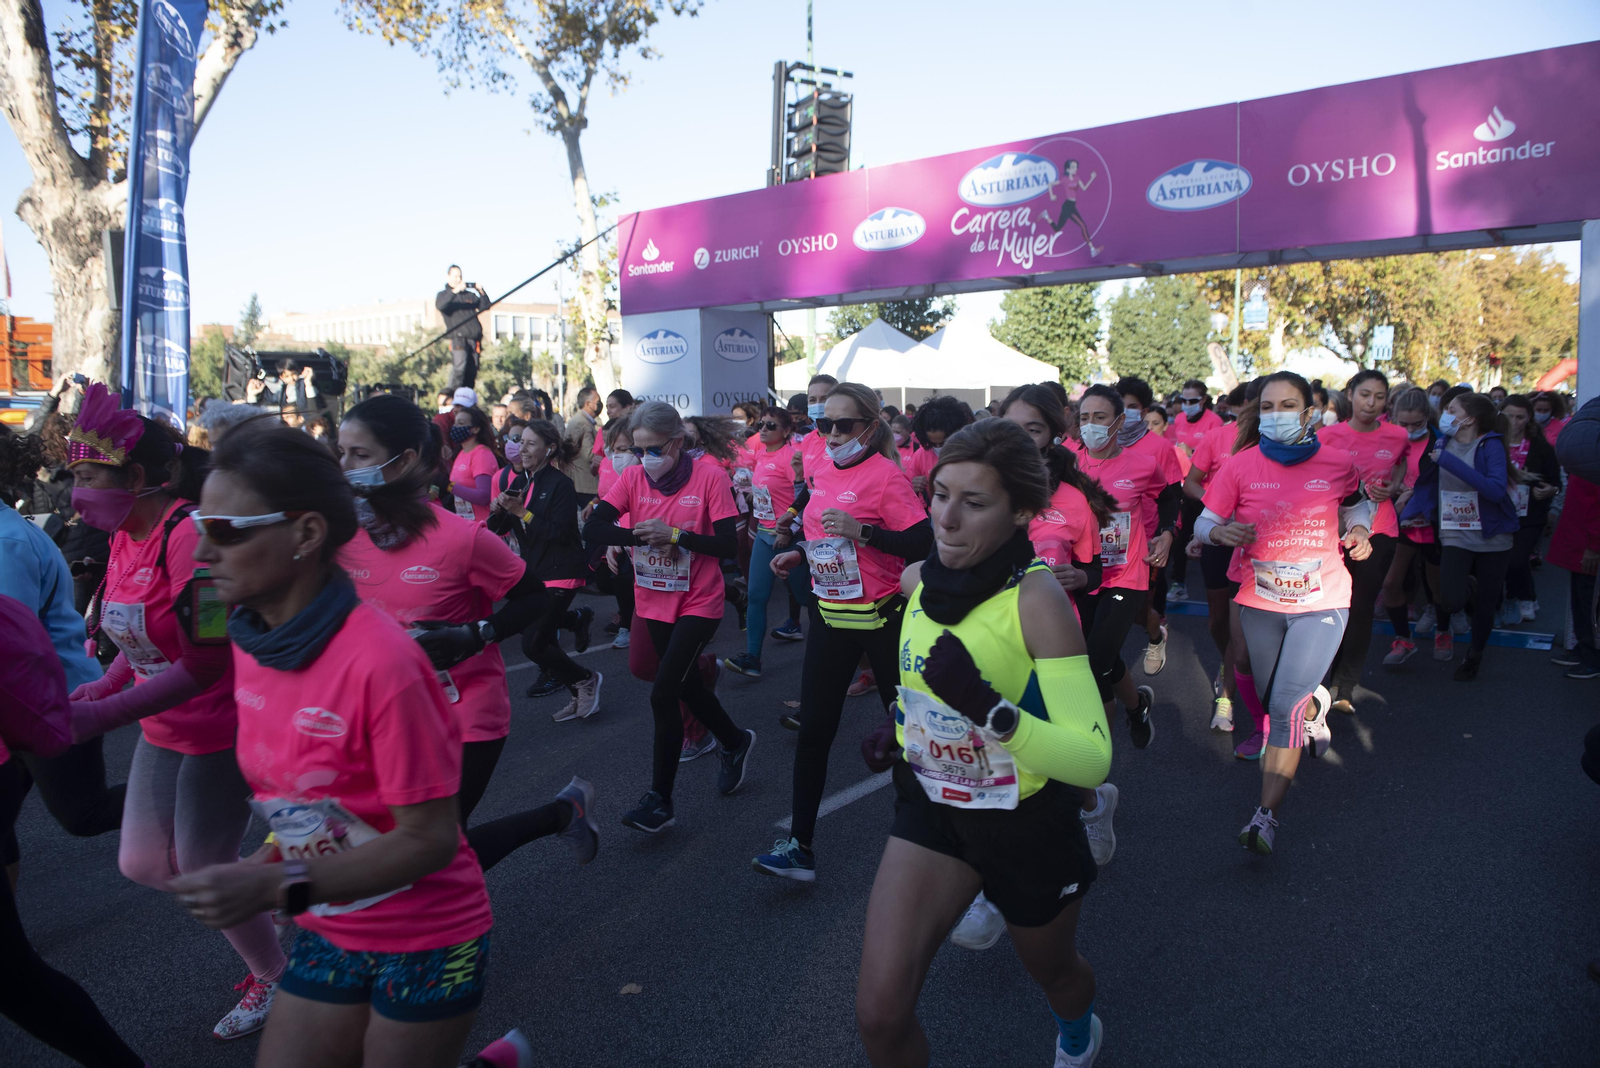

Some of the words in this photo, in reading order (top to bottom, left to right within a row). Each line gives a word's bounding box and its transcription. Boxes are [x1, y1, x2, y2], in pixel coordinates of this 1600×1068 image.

[1435, 141, 1556, 171] Santander
[1287, 152, 1396, 186] OYSHO
[967, 172, 1050, 197] ASTURIANA
[1155, 178, 1243, 202] ASTURIANA
[951, 207, 1031, 235] Carrera
[860, 225, 919, 243] ASTURIANA
[778, 232, 838, 256] OYSHO
[970, 233, 986, 253] de
[988, 232, 999, 251] la
[997, 222, 1063, 269] Mujer
[714, 245, 759, 263] ZURICH
[628, 261, 674, 277] Santander
[640, 344, 684, 356] ASTURIANA
[717, 339, 757, 354] ASTURIANA
[1250, 482, 1281, 490] OYSHO
[1453, 506, 1471, 515] 016
[1304, 519, 1326, 527] POR
[1100, 533, 1114, 544] 16
[1290, 529, 1325, 537] TODAS
[1268, 538, 1324, 548] NOSOTRAS
[648, 555, 672, 567] 016
[817, 562, 838, 574] 016
[1275, 577, 1303, 589] 016
[929, 739, 975, 765] 016
[941, 763, 966, 776] 3679
